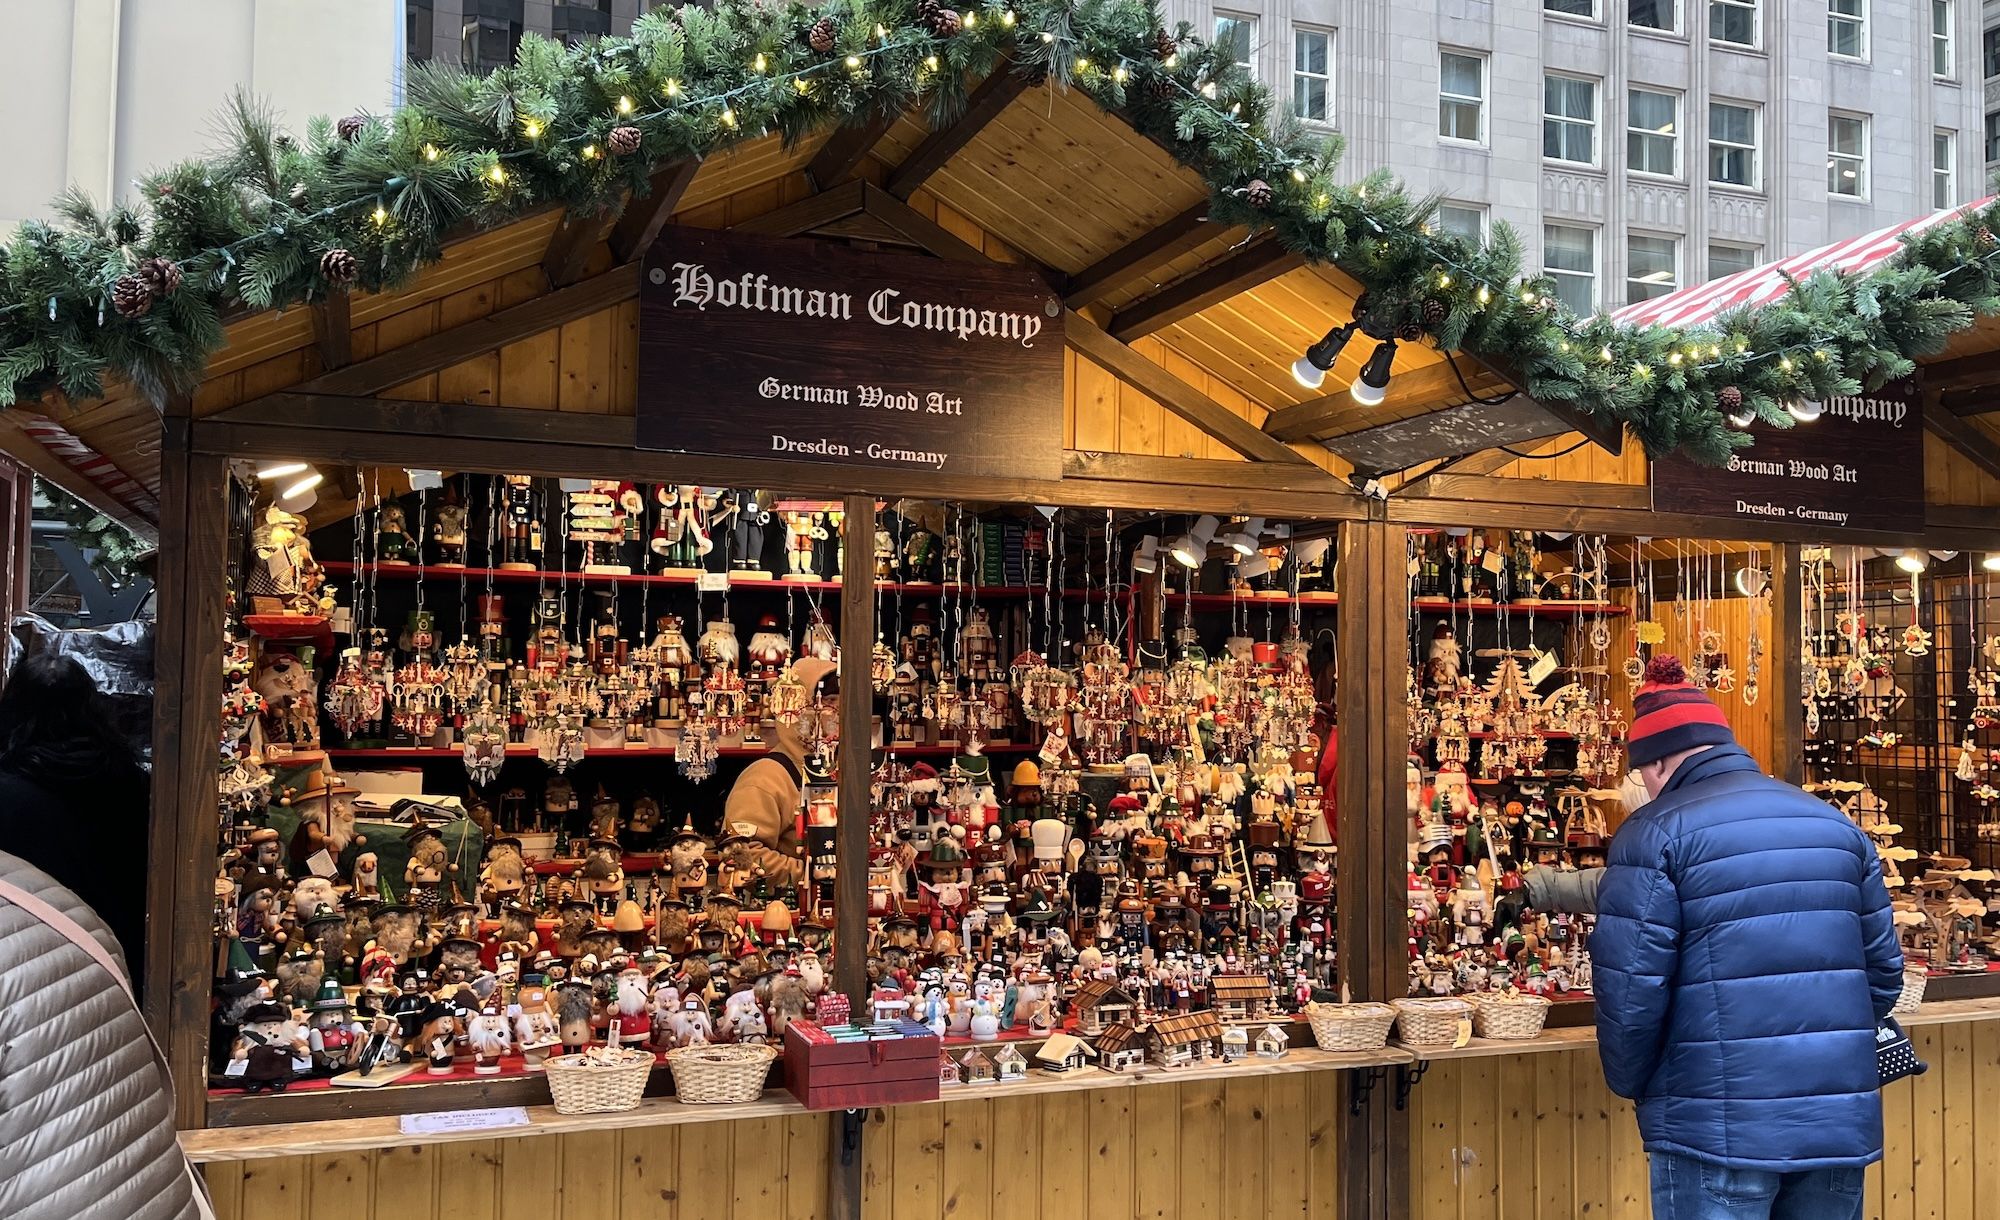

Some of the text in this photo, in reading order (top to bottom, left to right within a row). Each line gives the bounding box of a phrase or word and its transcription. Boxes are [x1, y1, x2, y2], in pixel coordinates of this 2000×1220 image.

[671, 262, 1042, 348] Hoffman Company
[758, 376, 963, 416] German Wood Art
[1820, 395, 1907, 429] ompany
[771, 434, 850, 458] Dresden
[867, 442, 948, 469] Germany
[1727, 454, 1858, 483] German Wood Art
[1736, 500, 1786, 517] Dresden
[1796, 505, 1849, 526] Germany
